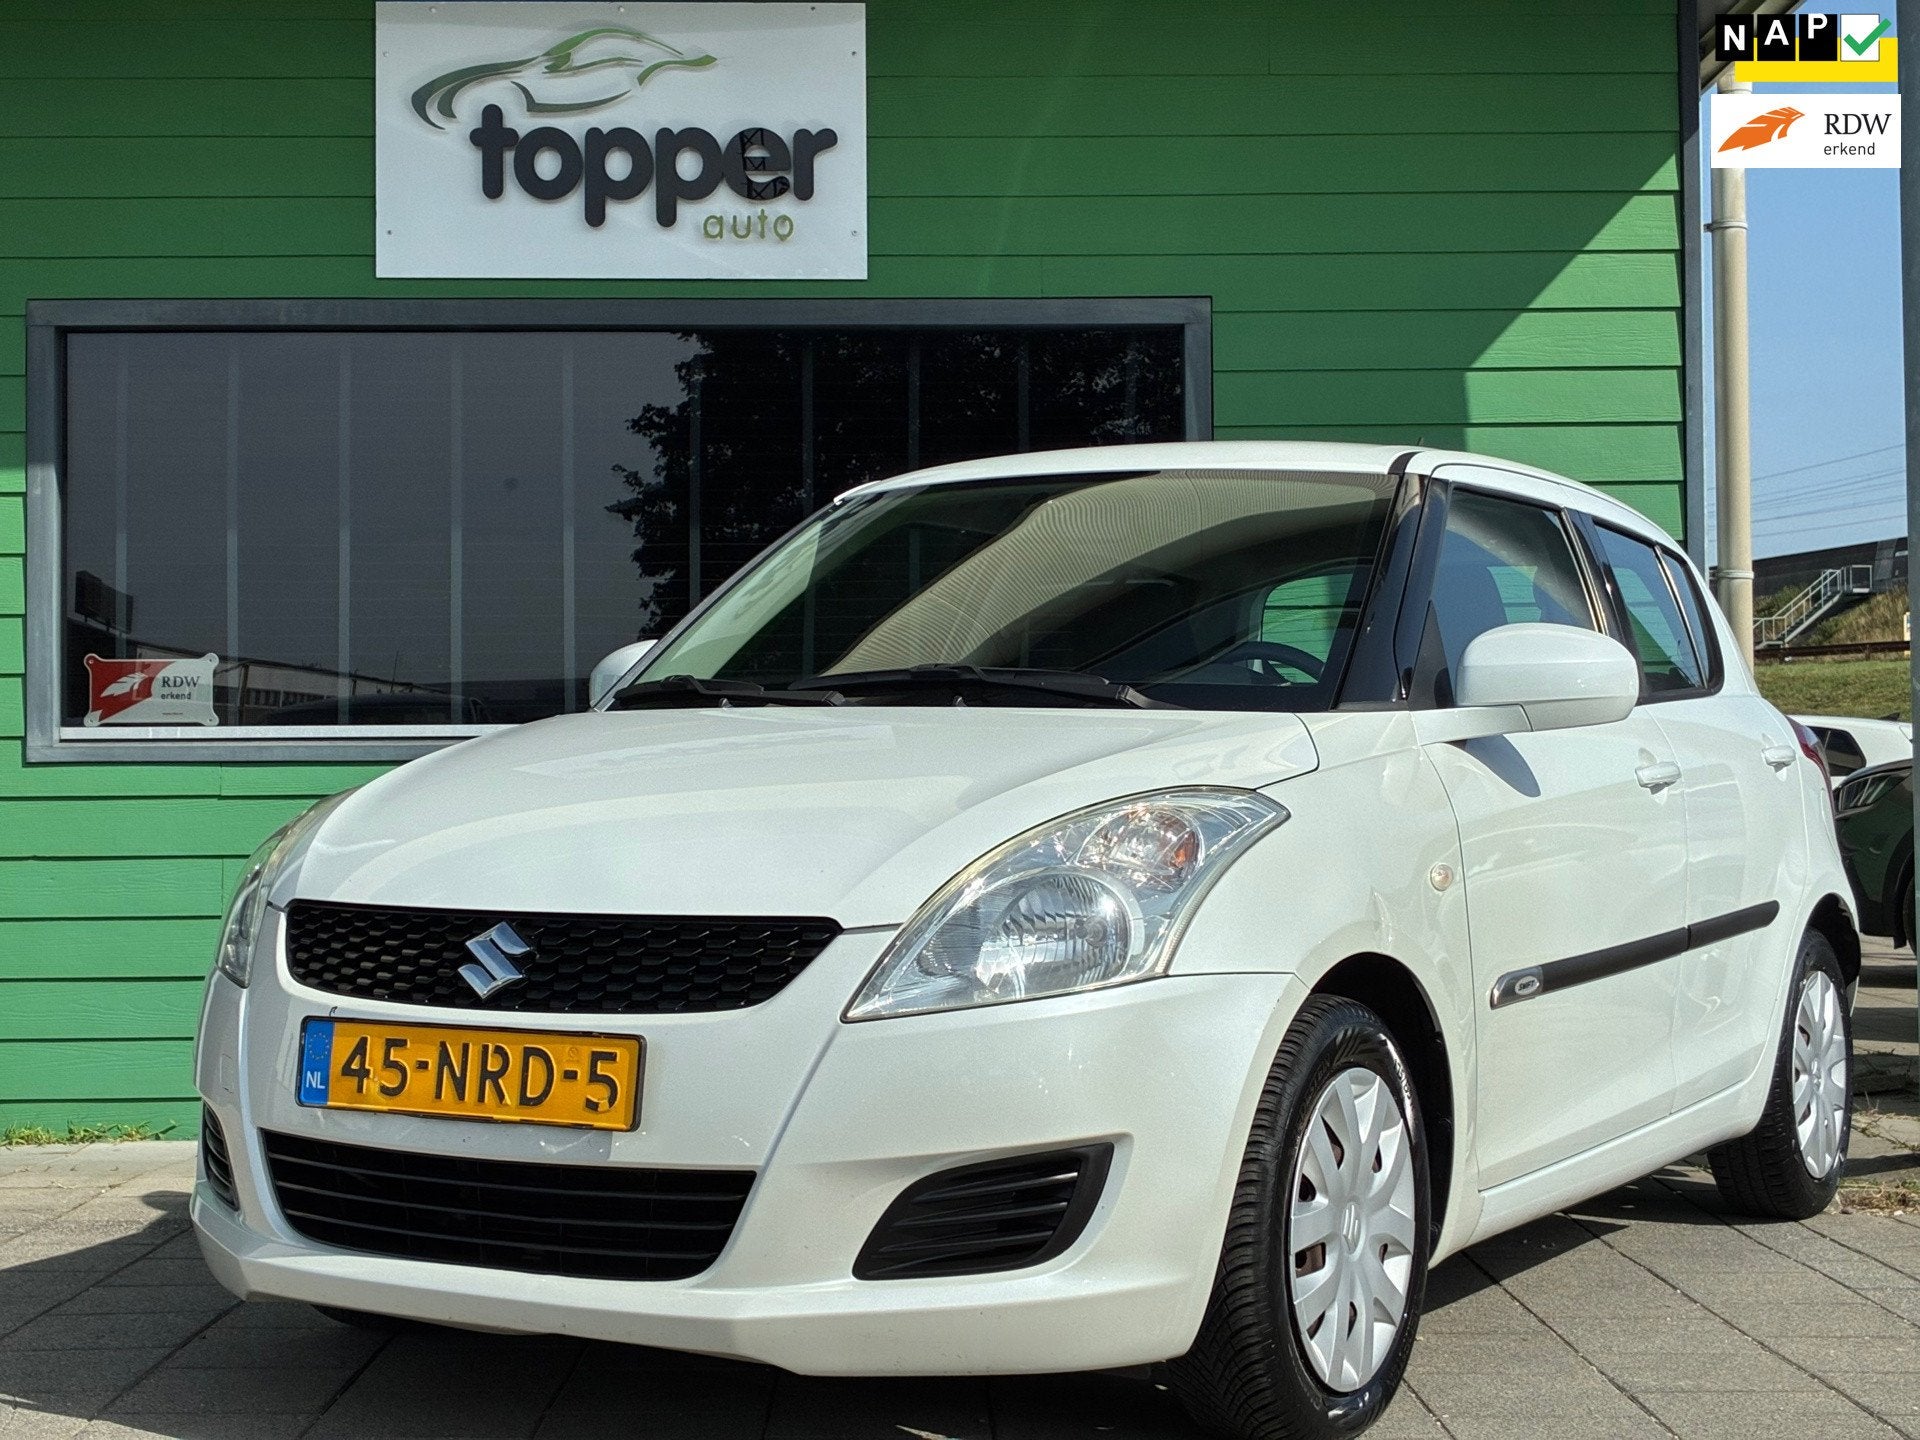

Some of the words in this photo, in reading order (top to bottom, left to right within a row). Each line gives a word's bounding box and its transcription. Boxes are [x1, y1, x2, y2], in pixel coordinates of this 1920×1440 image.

[469, 103, 838, 228] topper
[703, 209, 794, 241] auto
[161, 676, 200, 688] RDW
[161, 692, 191, 700] erkend
[306, 1070, 326, 1089] NL
[341, 1035, 619, 1113] 45-NRD-5
